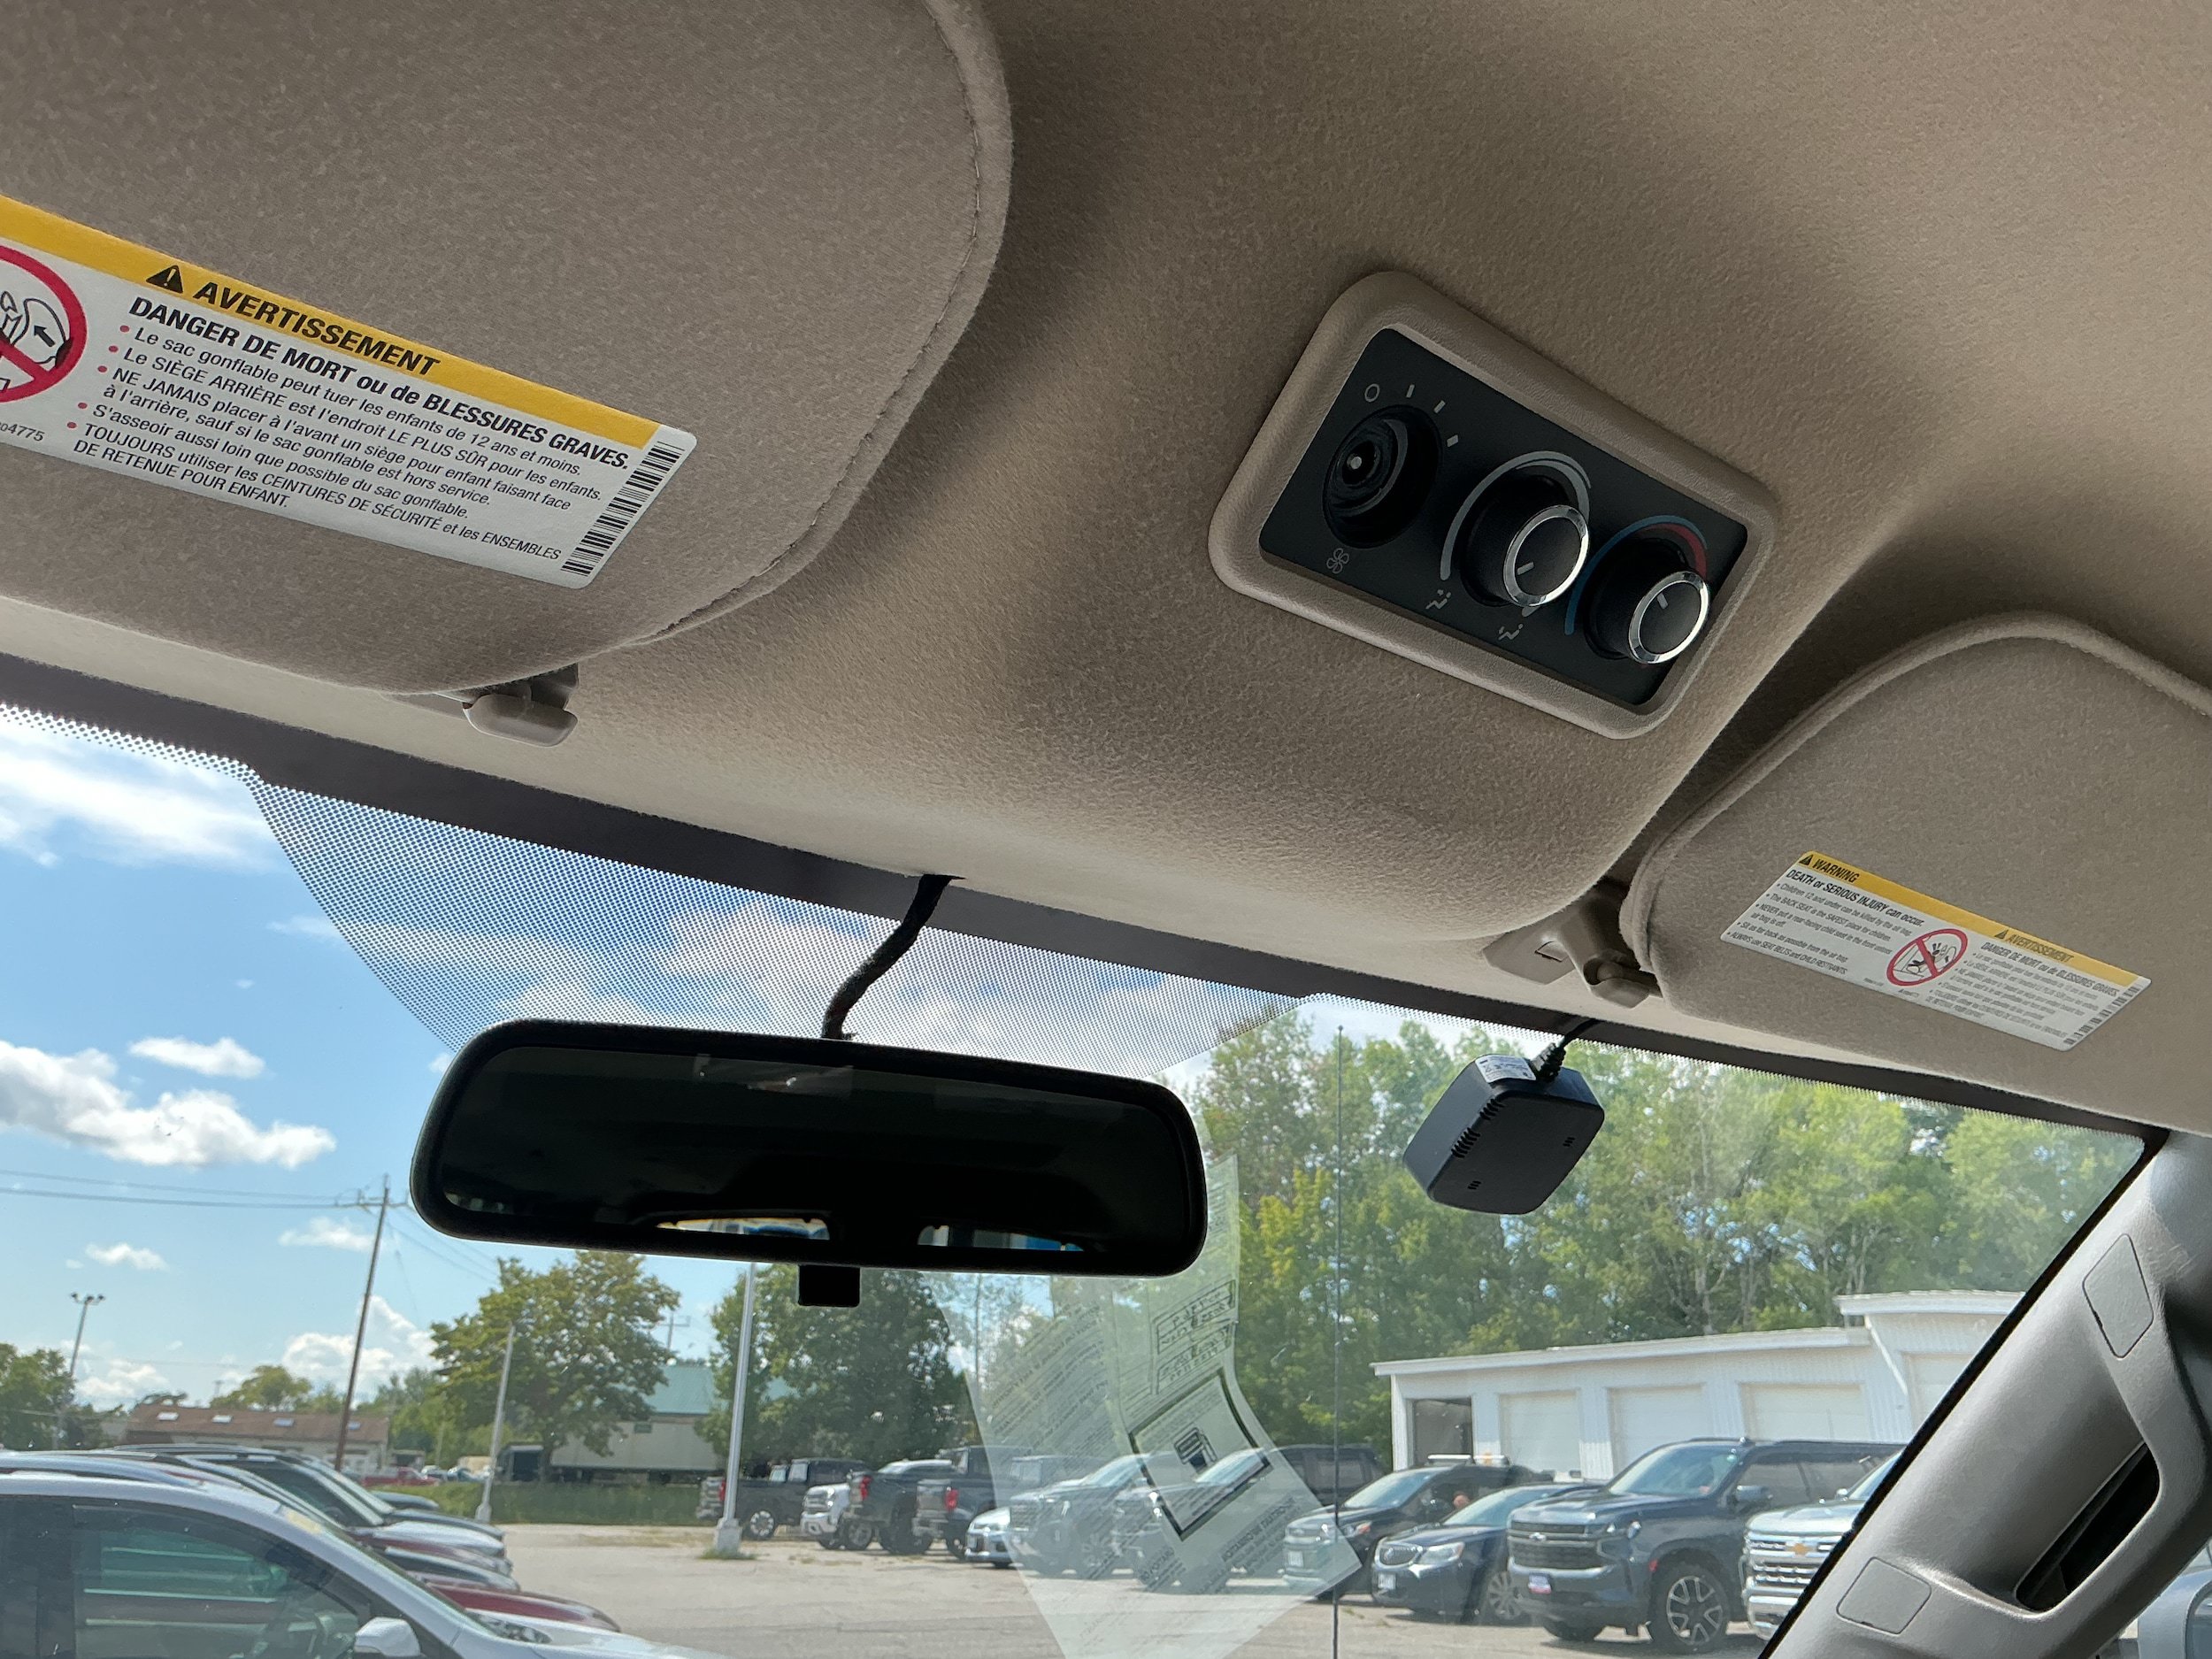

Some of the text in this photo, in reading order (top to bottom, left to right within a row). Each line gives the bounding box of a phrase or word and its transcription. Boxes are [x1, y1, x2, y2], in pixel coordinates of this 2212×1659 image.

[129, 296, 629, 470] DANGER DE MORT ou de BLESSURES GRAVES.
[194, 282, 440, 375] AVERTISSEMENT
[103, 383, 490, 506] à l'arrière, sauf si le sac gonflable est hors service.
[111, 367, 572, 511] NE JAMAIS placer à l'avant un siège pour enfant faisant face
[123, 347, 602, 501] Le SIÈGE ARRIÈRE est l'endroit LE PLUS SÛR pour les enfants.
[134, 326, 580, 476] Le sac gonflable peut tuer les enfants de 12 ans et moins.
[73, 439, 291, 508] DE RETENUE POUR ENFANT.
[84, 422, 562, 560] TOUJOURS utiliser les CEINTURES DE SÉCURITÉ et les ENSEMBLES
[92, 403, 468, 519] S'asseoir aussi loin que possible du sac gonflable.
[1786, 870, 1816, 885] DEATH
[1823, 883, 1860, 902] SERIOUS
[1856, 896, 1889, 912] INJURY
[1886, 909, 1902, 918] can
[1901, 914, 1924, 926] occur.
[1812, 858, 1860, 883] WARNING
[2008, 934, 2075, 963] AVERTISSEMENT
